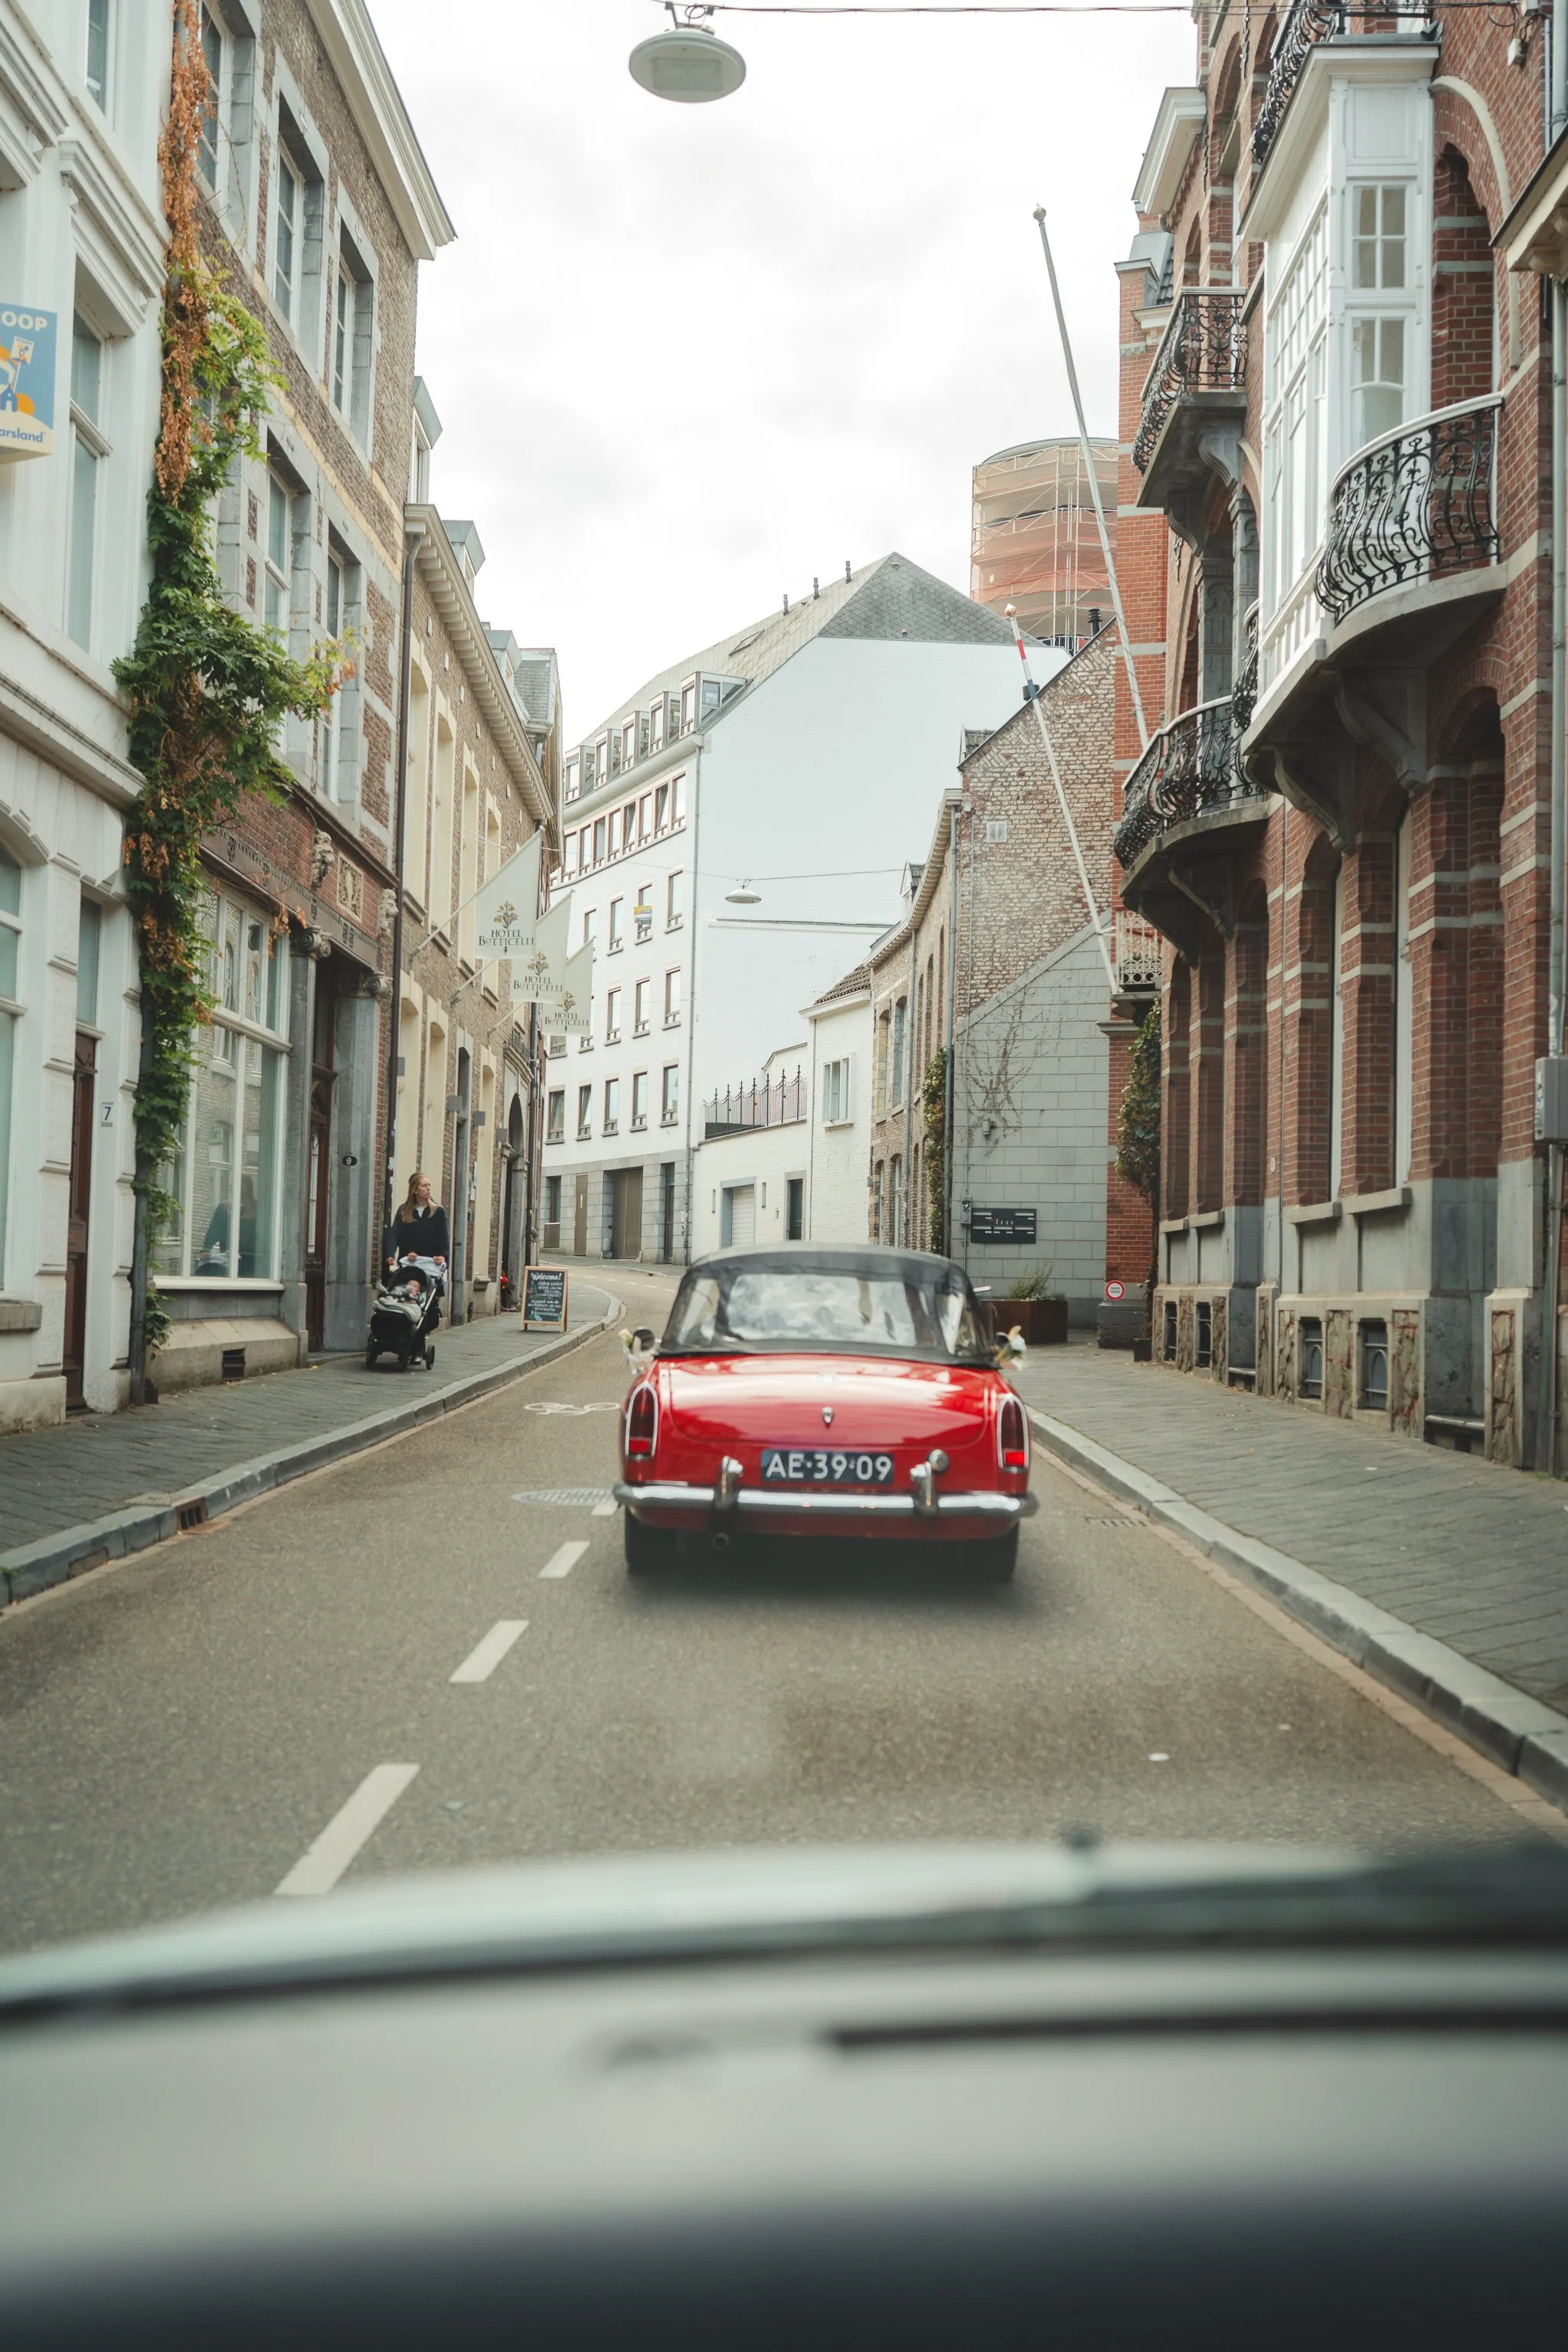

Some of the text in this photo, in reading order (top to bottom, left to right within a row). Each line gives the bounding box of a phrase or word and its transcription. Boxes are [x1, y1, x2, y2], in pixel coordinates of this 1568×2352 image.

[0, 311, 47, 332] OOP
[0, 427, 43, 443] arsland
[491, 929, 522, 938] HOTEL
[478, 936, 534, 946] BOTTICELLI
[524, 975, 552, 985] HOTEL
[104, 1106, 111, 1121] 7
[345, 1157, 351, 1165] 9
[531, 1272, 562, 1281] Welcome!
